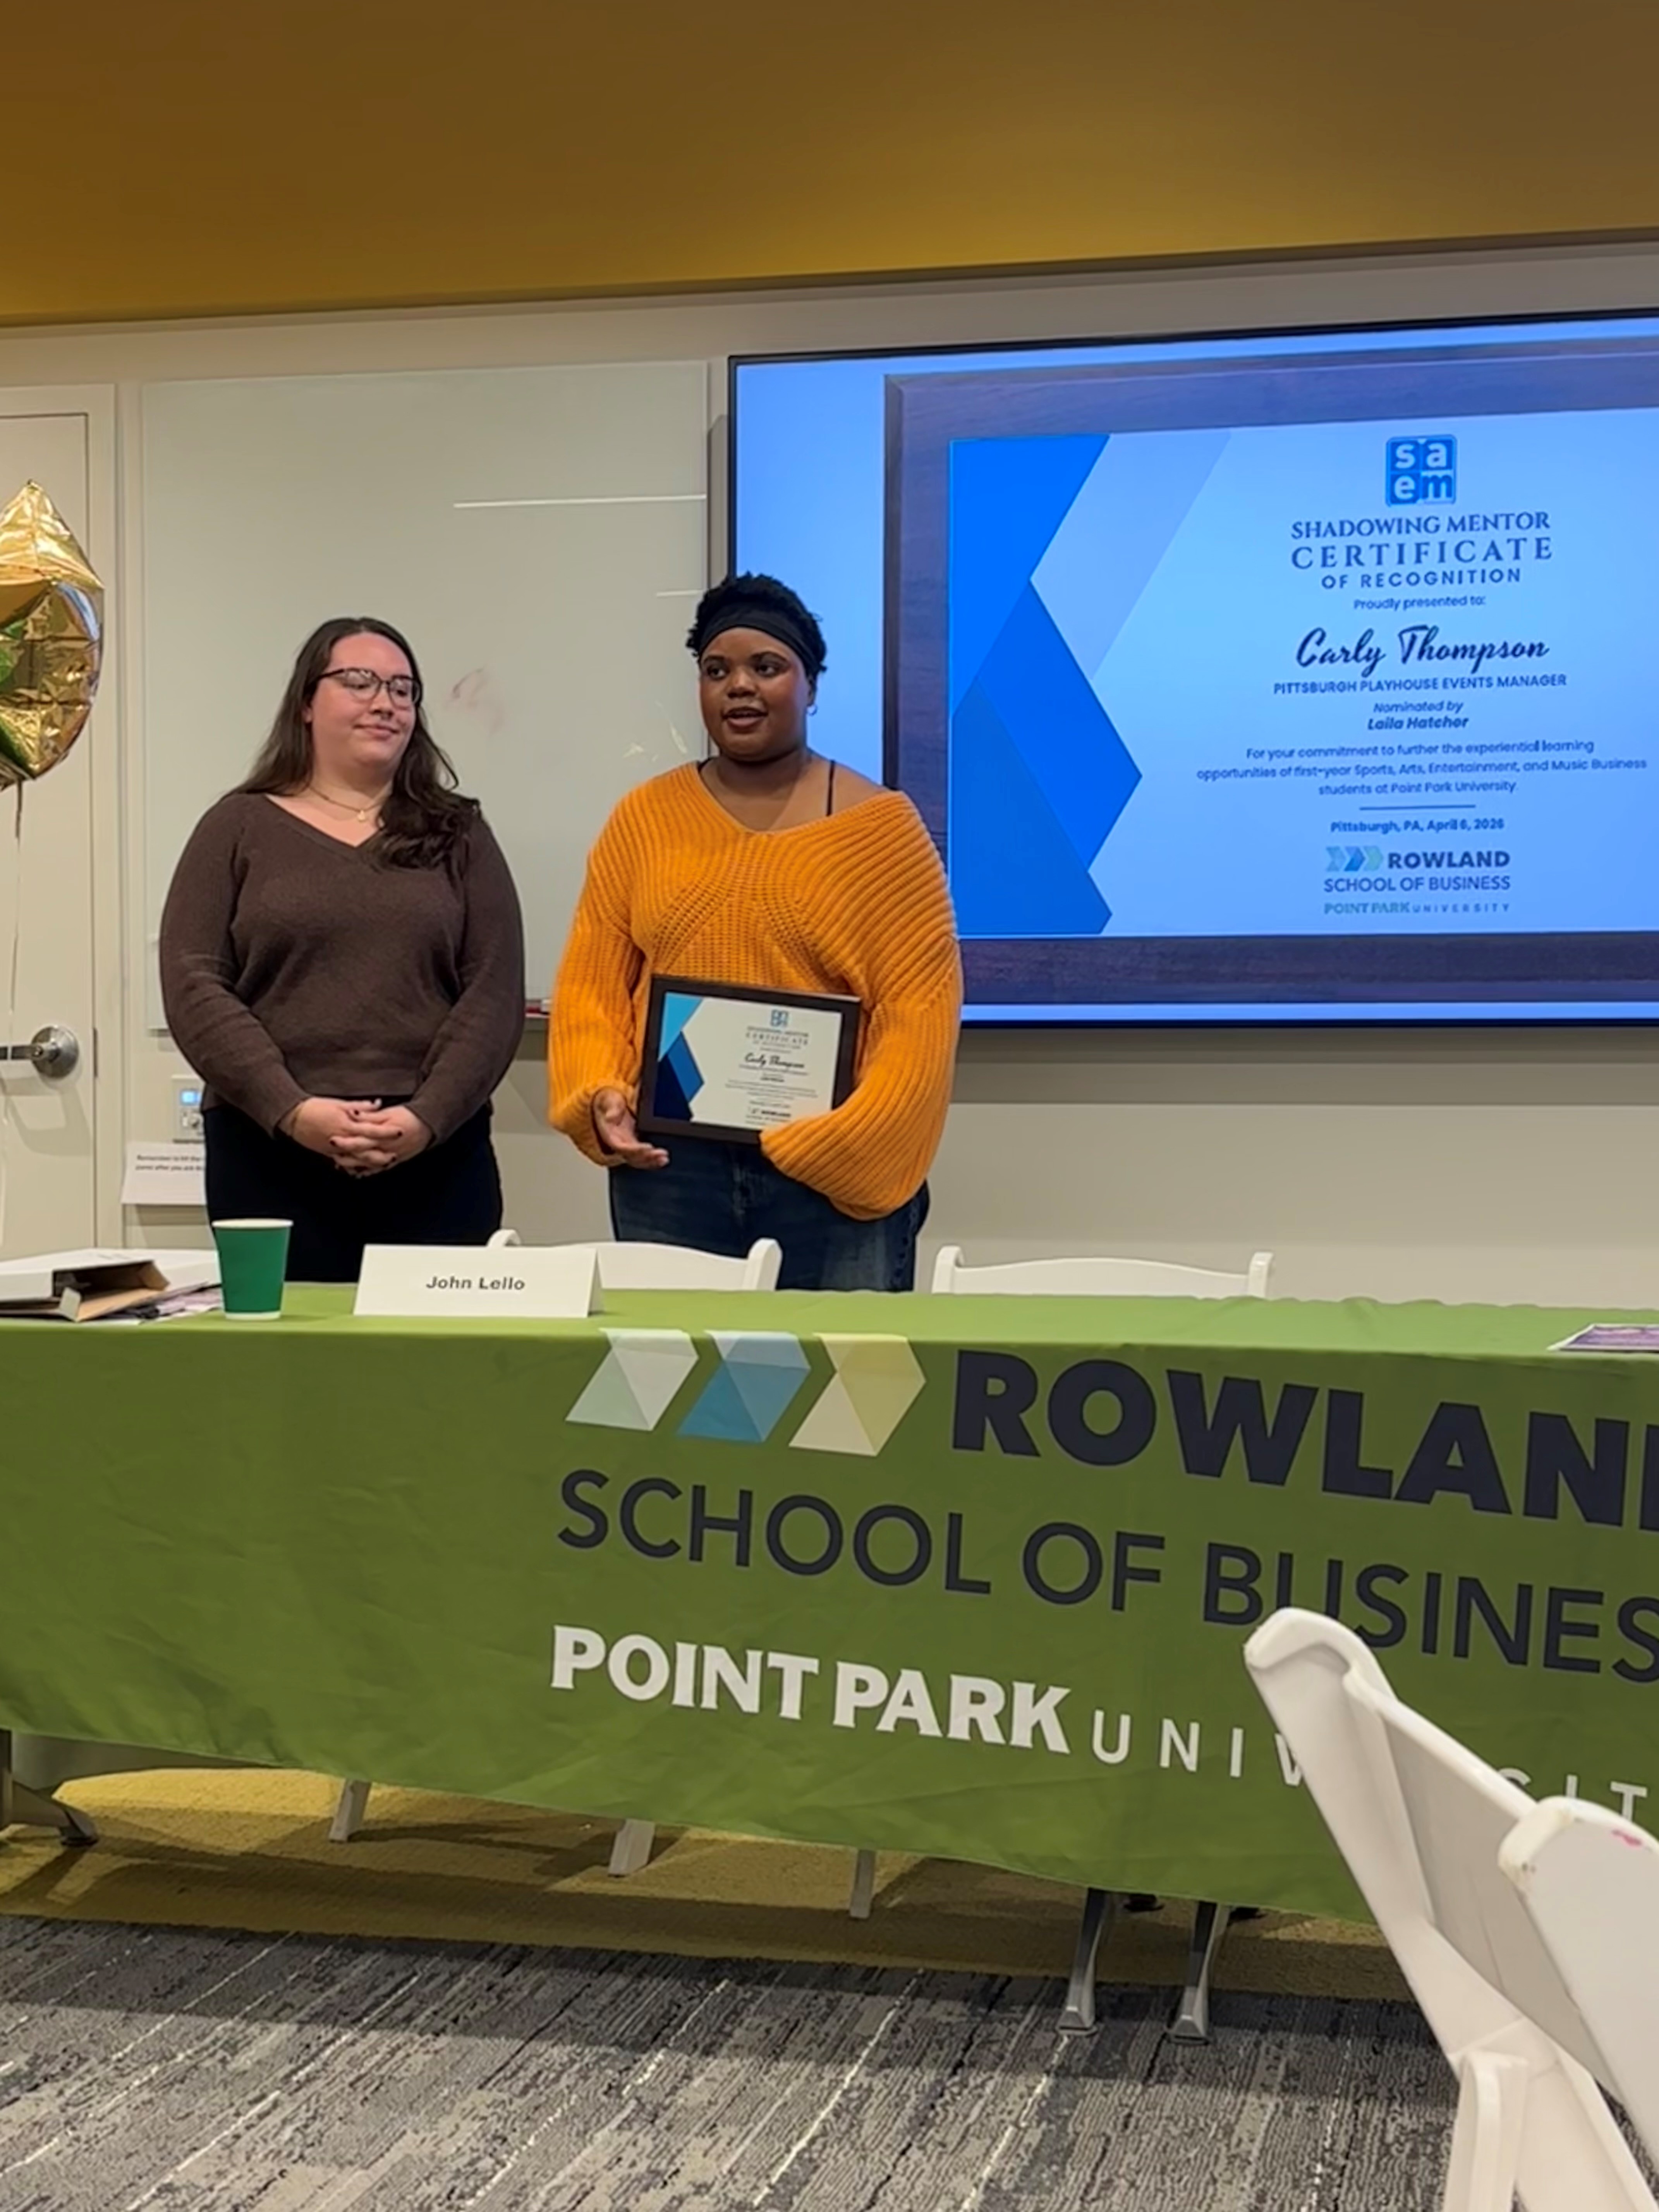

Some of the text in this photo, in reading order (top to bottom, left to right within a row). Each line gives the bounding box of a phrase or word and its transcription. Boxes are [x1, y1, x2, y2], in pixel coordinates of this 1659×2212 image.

[1291, 512, 1550, 539] SHADOWING MENTOR
[1291, 537, 1552, 570] CERTIFICATE
[1322, 568, 1520, 589] OF RECOGNITION
[1354, 598, 1401, 611] Proudly
[1403, 596, 1467, 611] presented
[1296, 625, 1549, 678] Carly Thompson
[1274, 674, 1566, 694] PITTSBURGH PLAYHOUSE EVENTS MANAGER
[1373, 701, 1463, 714] Nominated by
[1368, 716, 1469, 730] Laila Hatcher
[1247, 740, 1594, 761] For your commitment to further the experiential learning
[1197, 759, 1647, 782] opportunities of first-year Sports, Arts, Entertainment, and Music Business
[1319, 784, 1372, 795] students
[1375, 784, 1388, 794] at
[1391, 783, 1422, 793] Point
[1425, 781, 1452, 792] Park
[1331, 821, 1401, 835] Pittsburgh,
[1404, 820, 1424, 832] PA,
[1427, 819, 1458, 833] April
[1388, 851, 1510, 869] ROWLAND
[1324, 876, 1510, 893] SCHOOL OF BUSINESS
[1413, 903, 1509, 913] UNIVERSITY
[426, 1276, 525, 1290] John Lello
[952, 1349, 1659, 1532] ROWLAN
[558, 1469, 991, 1594] SCHOOL
[1023, 1522, 1165, 1612] OF
[551, 1625, 819, 1719] POINT
[833, 1661, 1070, 1753] PARK
